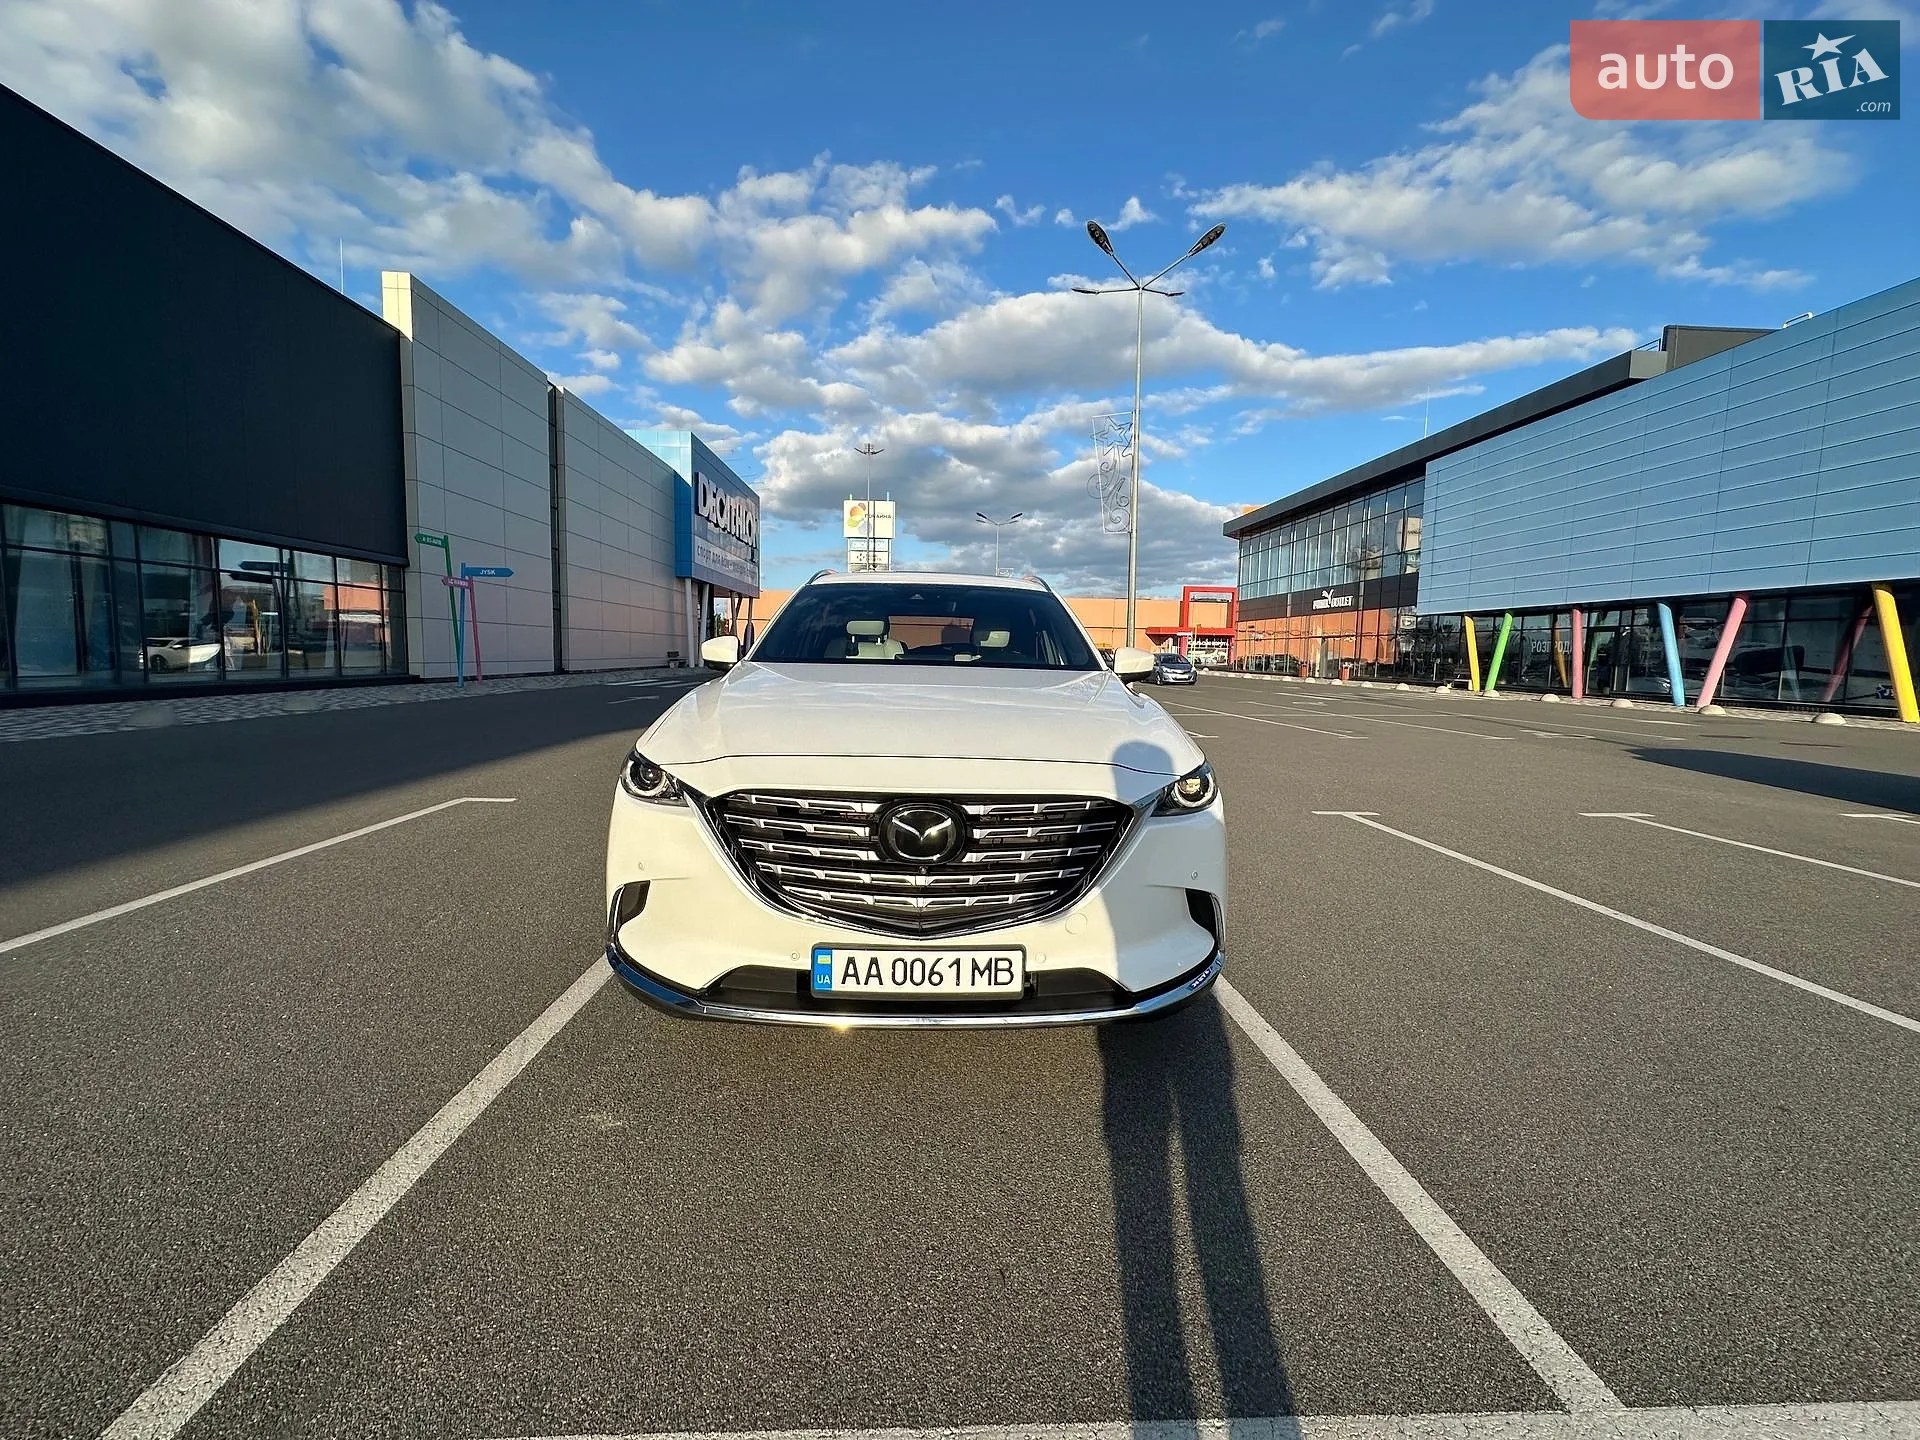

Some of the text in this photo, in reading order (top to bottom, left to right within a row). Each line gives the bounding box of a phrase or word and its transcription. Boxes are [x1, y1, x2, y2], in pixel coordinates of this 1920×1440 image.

[697, 471, 758, 549] DECATHLON
[816, 974, 831, 985] UA
[891, 957, 961, 987] 0061
[970, 957, 1015, 987] MB
